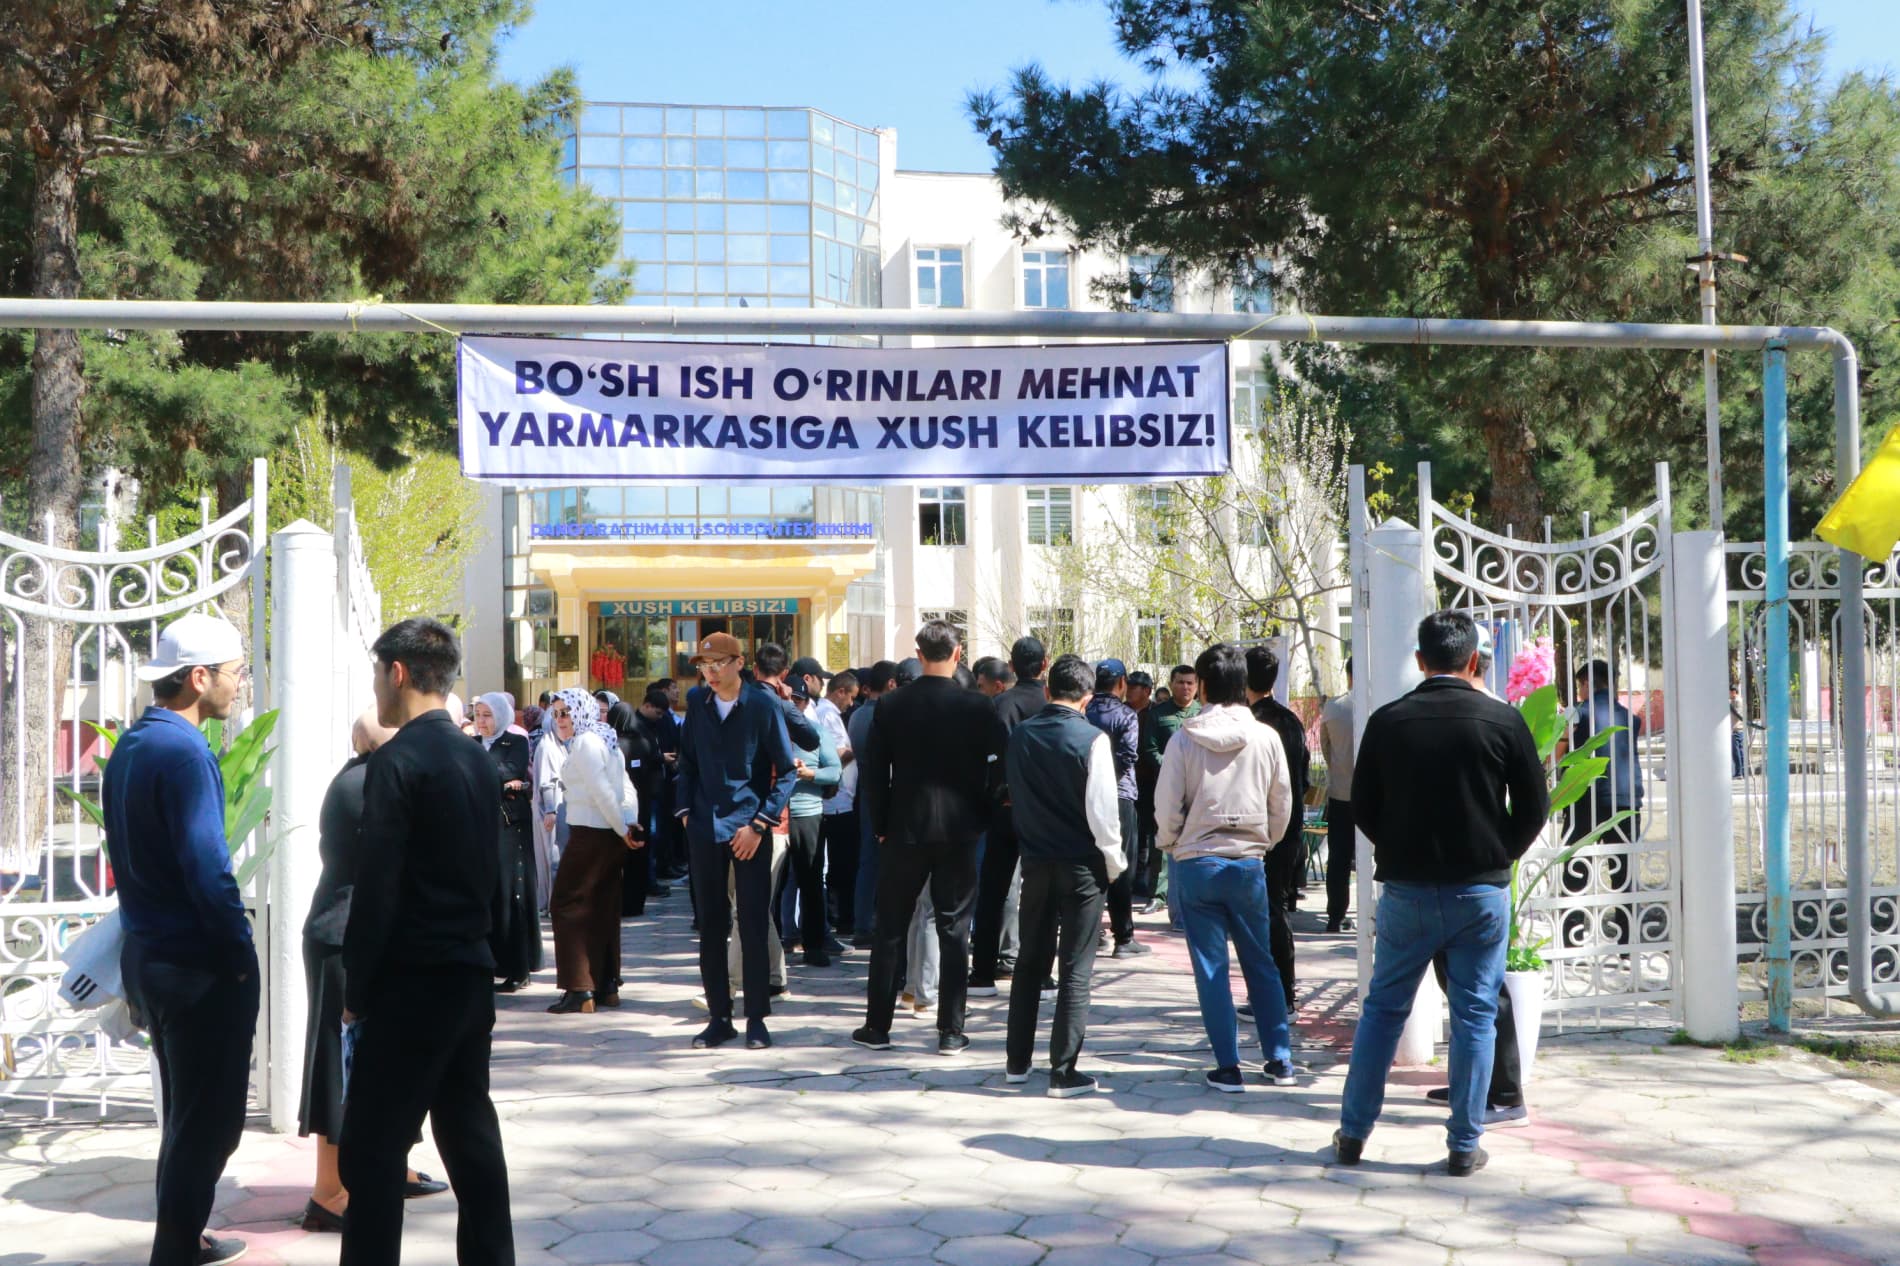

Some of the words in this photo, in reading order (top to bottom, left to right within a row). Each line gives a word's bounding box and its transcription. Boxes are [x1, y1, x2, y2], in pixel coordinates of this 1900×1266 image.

[515, 360, 659, 398] BO‘SH
[680, 365, 754, 400] ISH
[773, 367, 1002, 402] O‘RINLARI
[1016, 365, 1201, 400] MEHNAT
[479, 412, 859, 450] YARMARKASIGA
[876, 415, 999, 450] XUSH
[1017, 412, 1215, 449] KELIBSIZ!
[622, 523, 684, 536] TUMAN
[743, 522, 873, 536] POLITEXNIKUMI
[613, 601, 673, 615] XUSH
[680, 599, 786, 614] KELIBSIZ!
